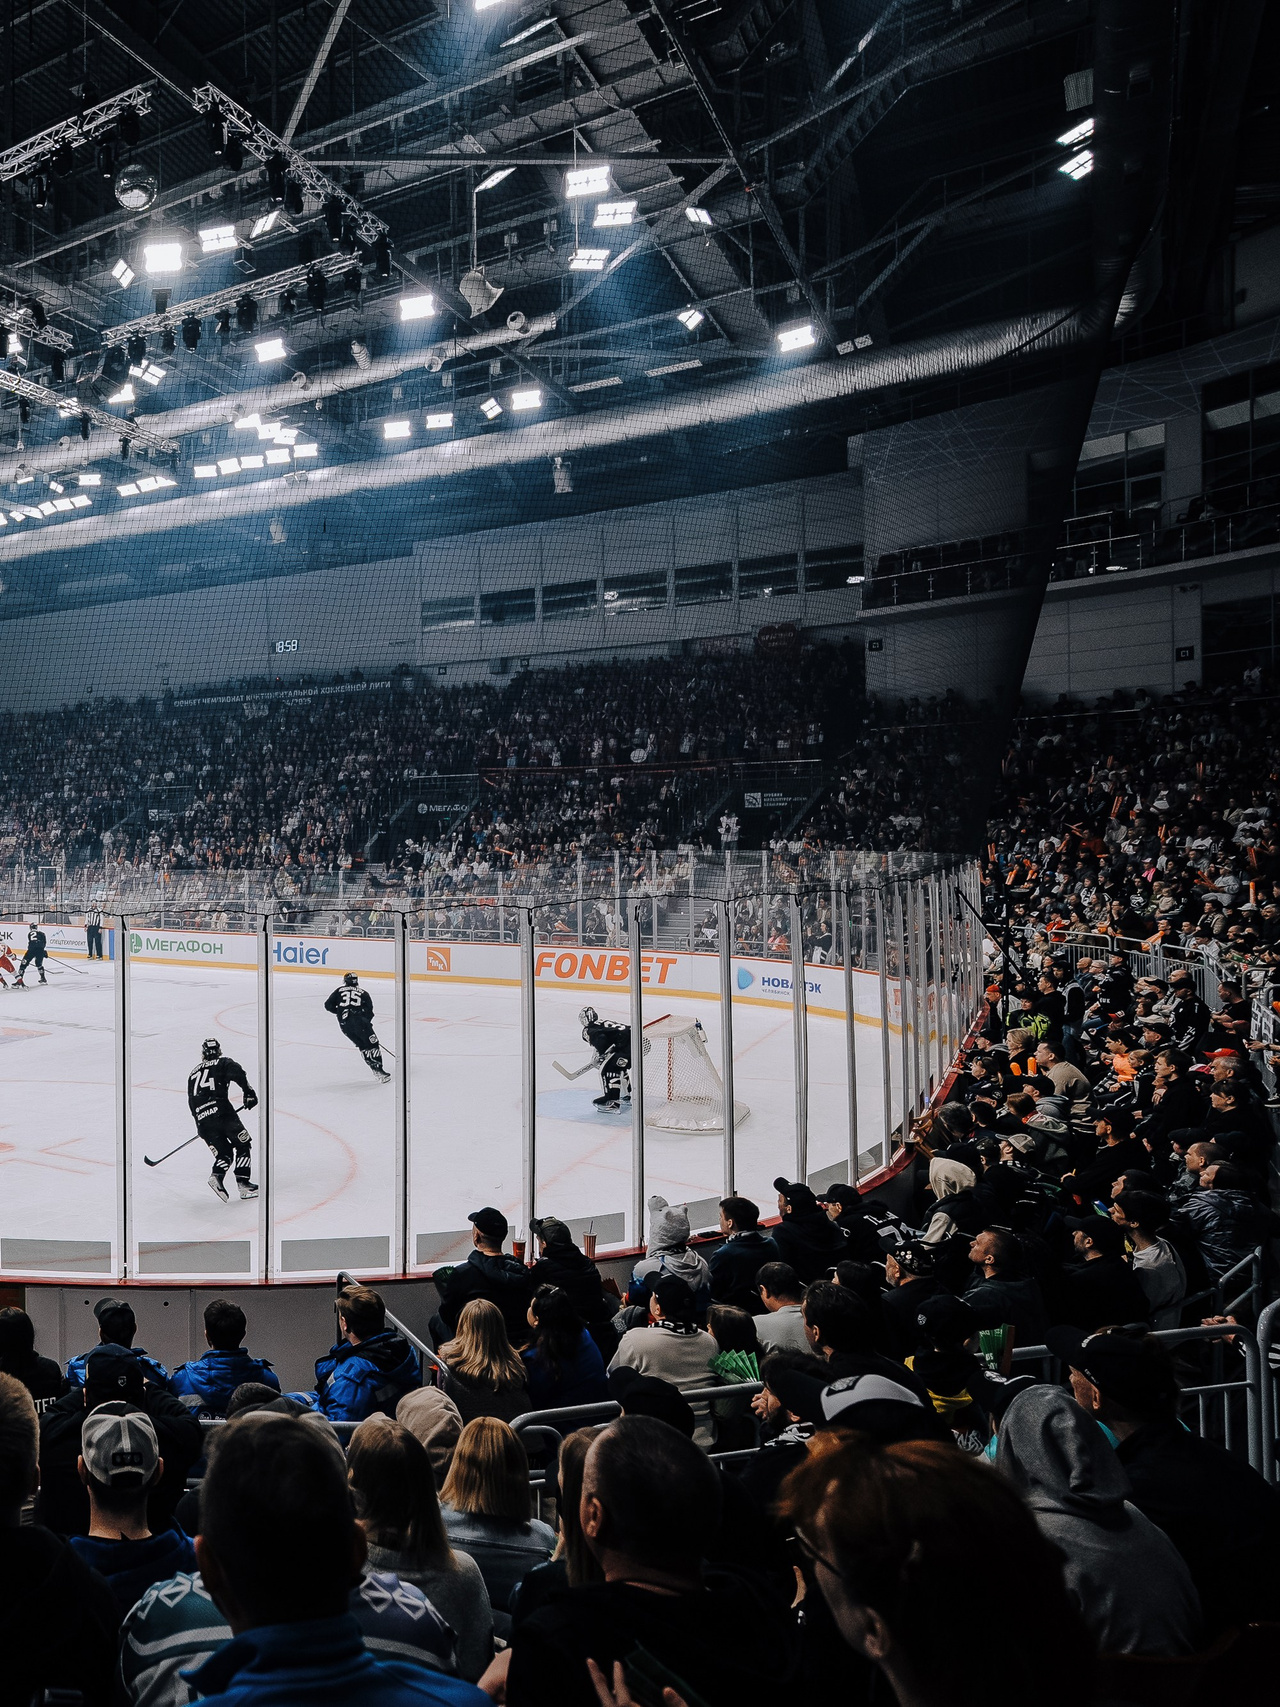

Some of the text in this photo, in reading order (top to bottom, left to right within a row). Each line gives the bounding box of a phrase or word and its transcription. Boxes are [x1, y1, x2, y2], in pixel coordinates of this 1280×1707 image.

[275, 639, 298, 653] 18:58
[320, 682, 367, 695] ХОККЕЙНОЙ
[368, 681, 391, 691] ЛИГИ
[429, 804, 469, 812] МЕГАФО
[30, 932, 38, 941] 2
[535, 951, 678, 985] FONBET
[340, 990, 362, 1007] 35
[190, 1069, 216, 1096] 74
